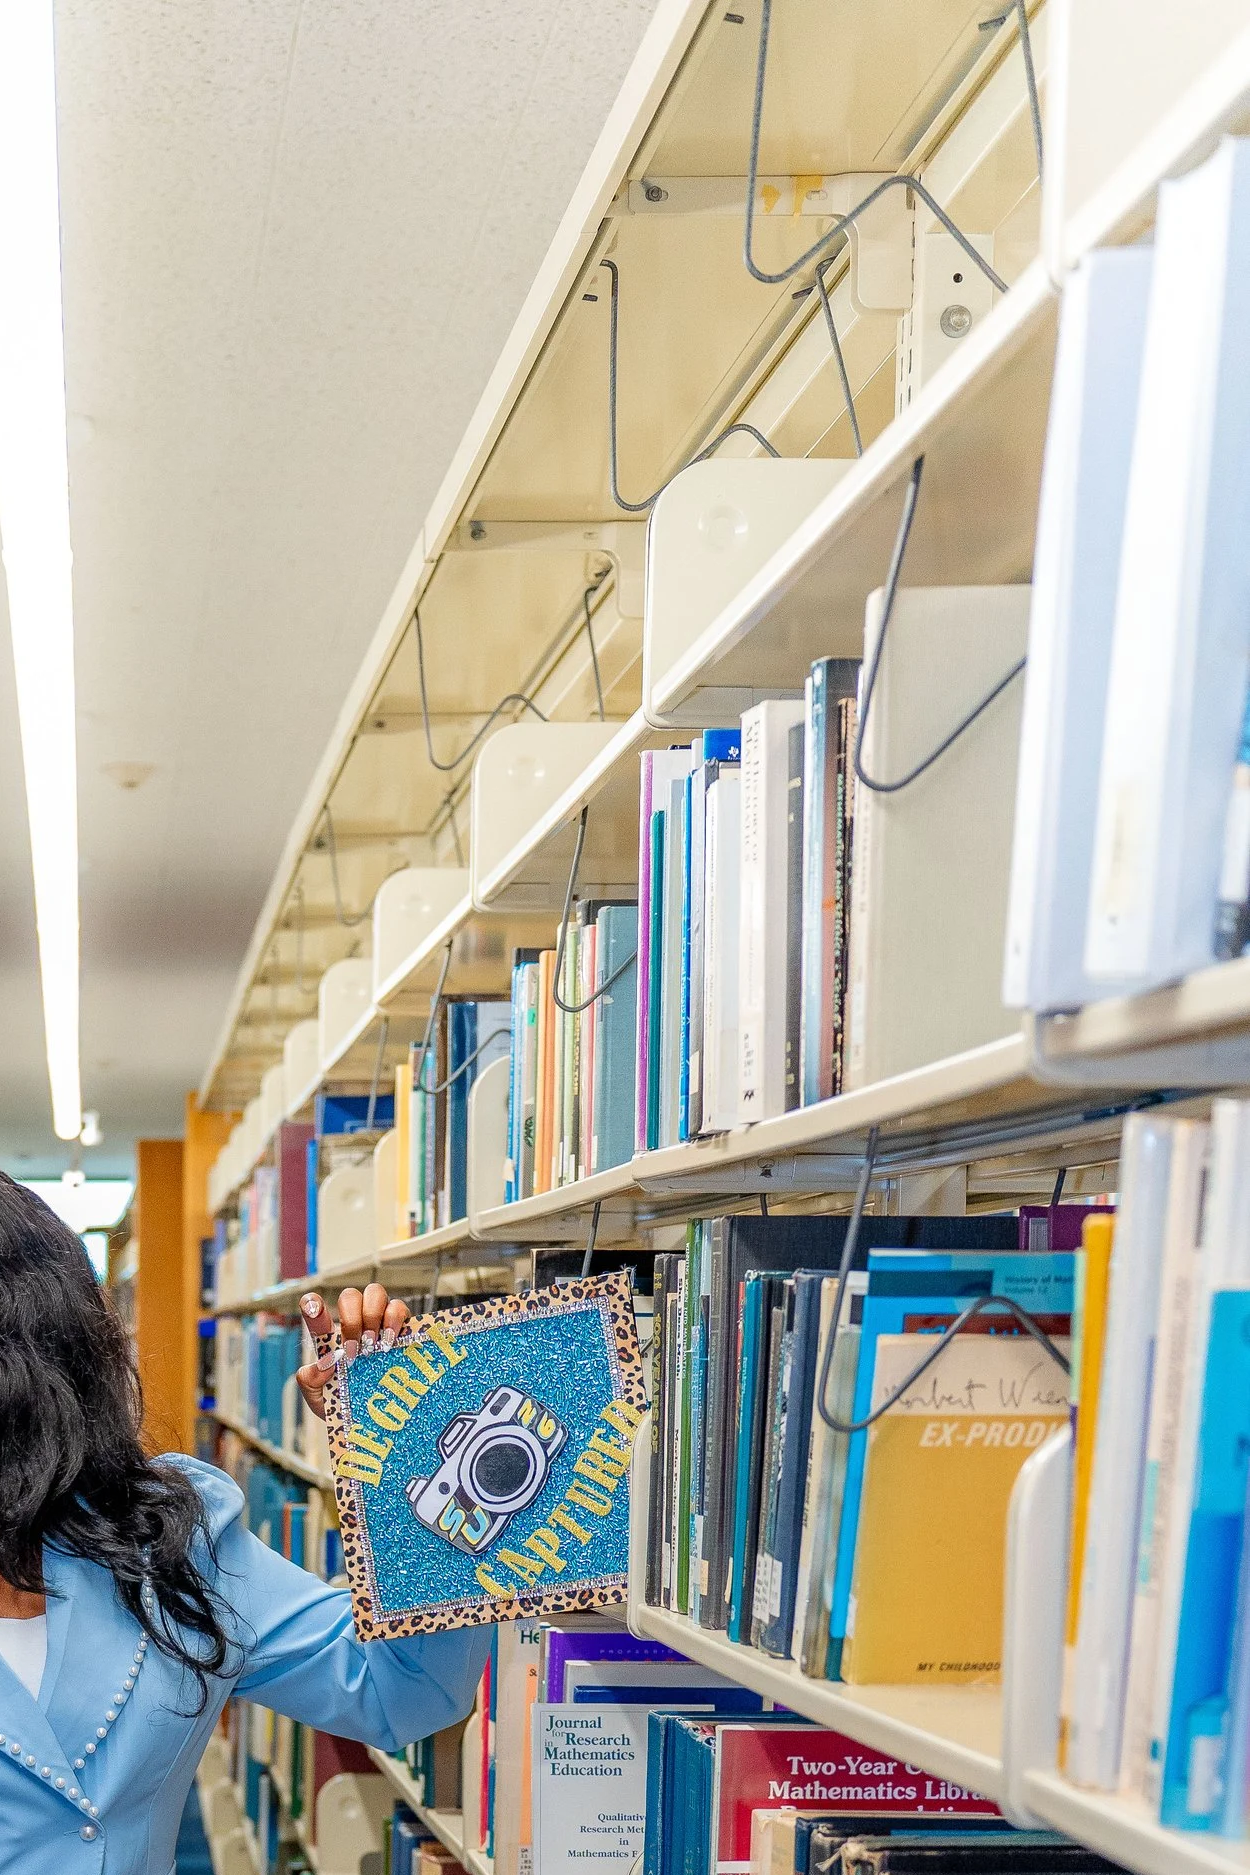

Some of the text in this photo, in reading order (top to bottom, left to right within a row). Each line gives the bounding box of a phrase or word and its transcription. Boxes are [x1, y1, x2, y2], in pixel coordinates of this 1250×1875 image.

[651, 1313, 662, 1453] 100 YEARS OF
[335, 1322, 468, 1487] DEGREE
[475, 1398, 647, 1601] CAPTURED
[917, 1661, 1000, 1673] MY CHILDHOOD
[546, 1715, 602, 1731] Journal
[551, 1729, 631, 1746] for Research
[544, 1738, 635, 1760] in Mathematics
[551, 1762, 623, 1776] Education
[787, 1756, 897, 1776] Two-Year
[768, 1781, 916, 1800] Mathematics
[598, 1813, 645, 1823] Qualitativ
[580, 1825, 644, 1834] Research Met
[619, 1838, 629, 1846] in
[567, 1849, 629, 1858] Mathematics
